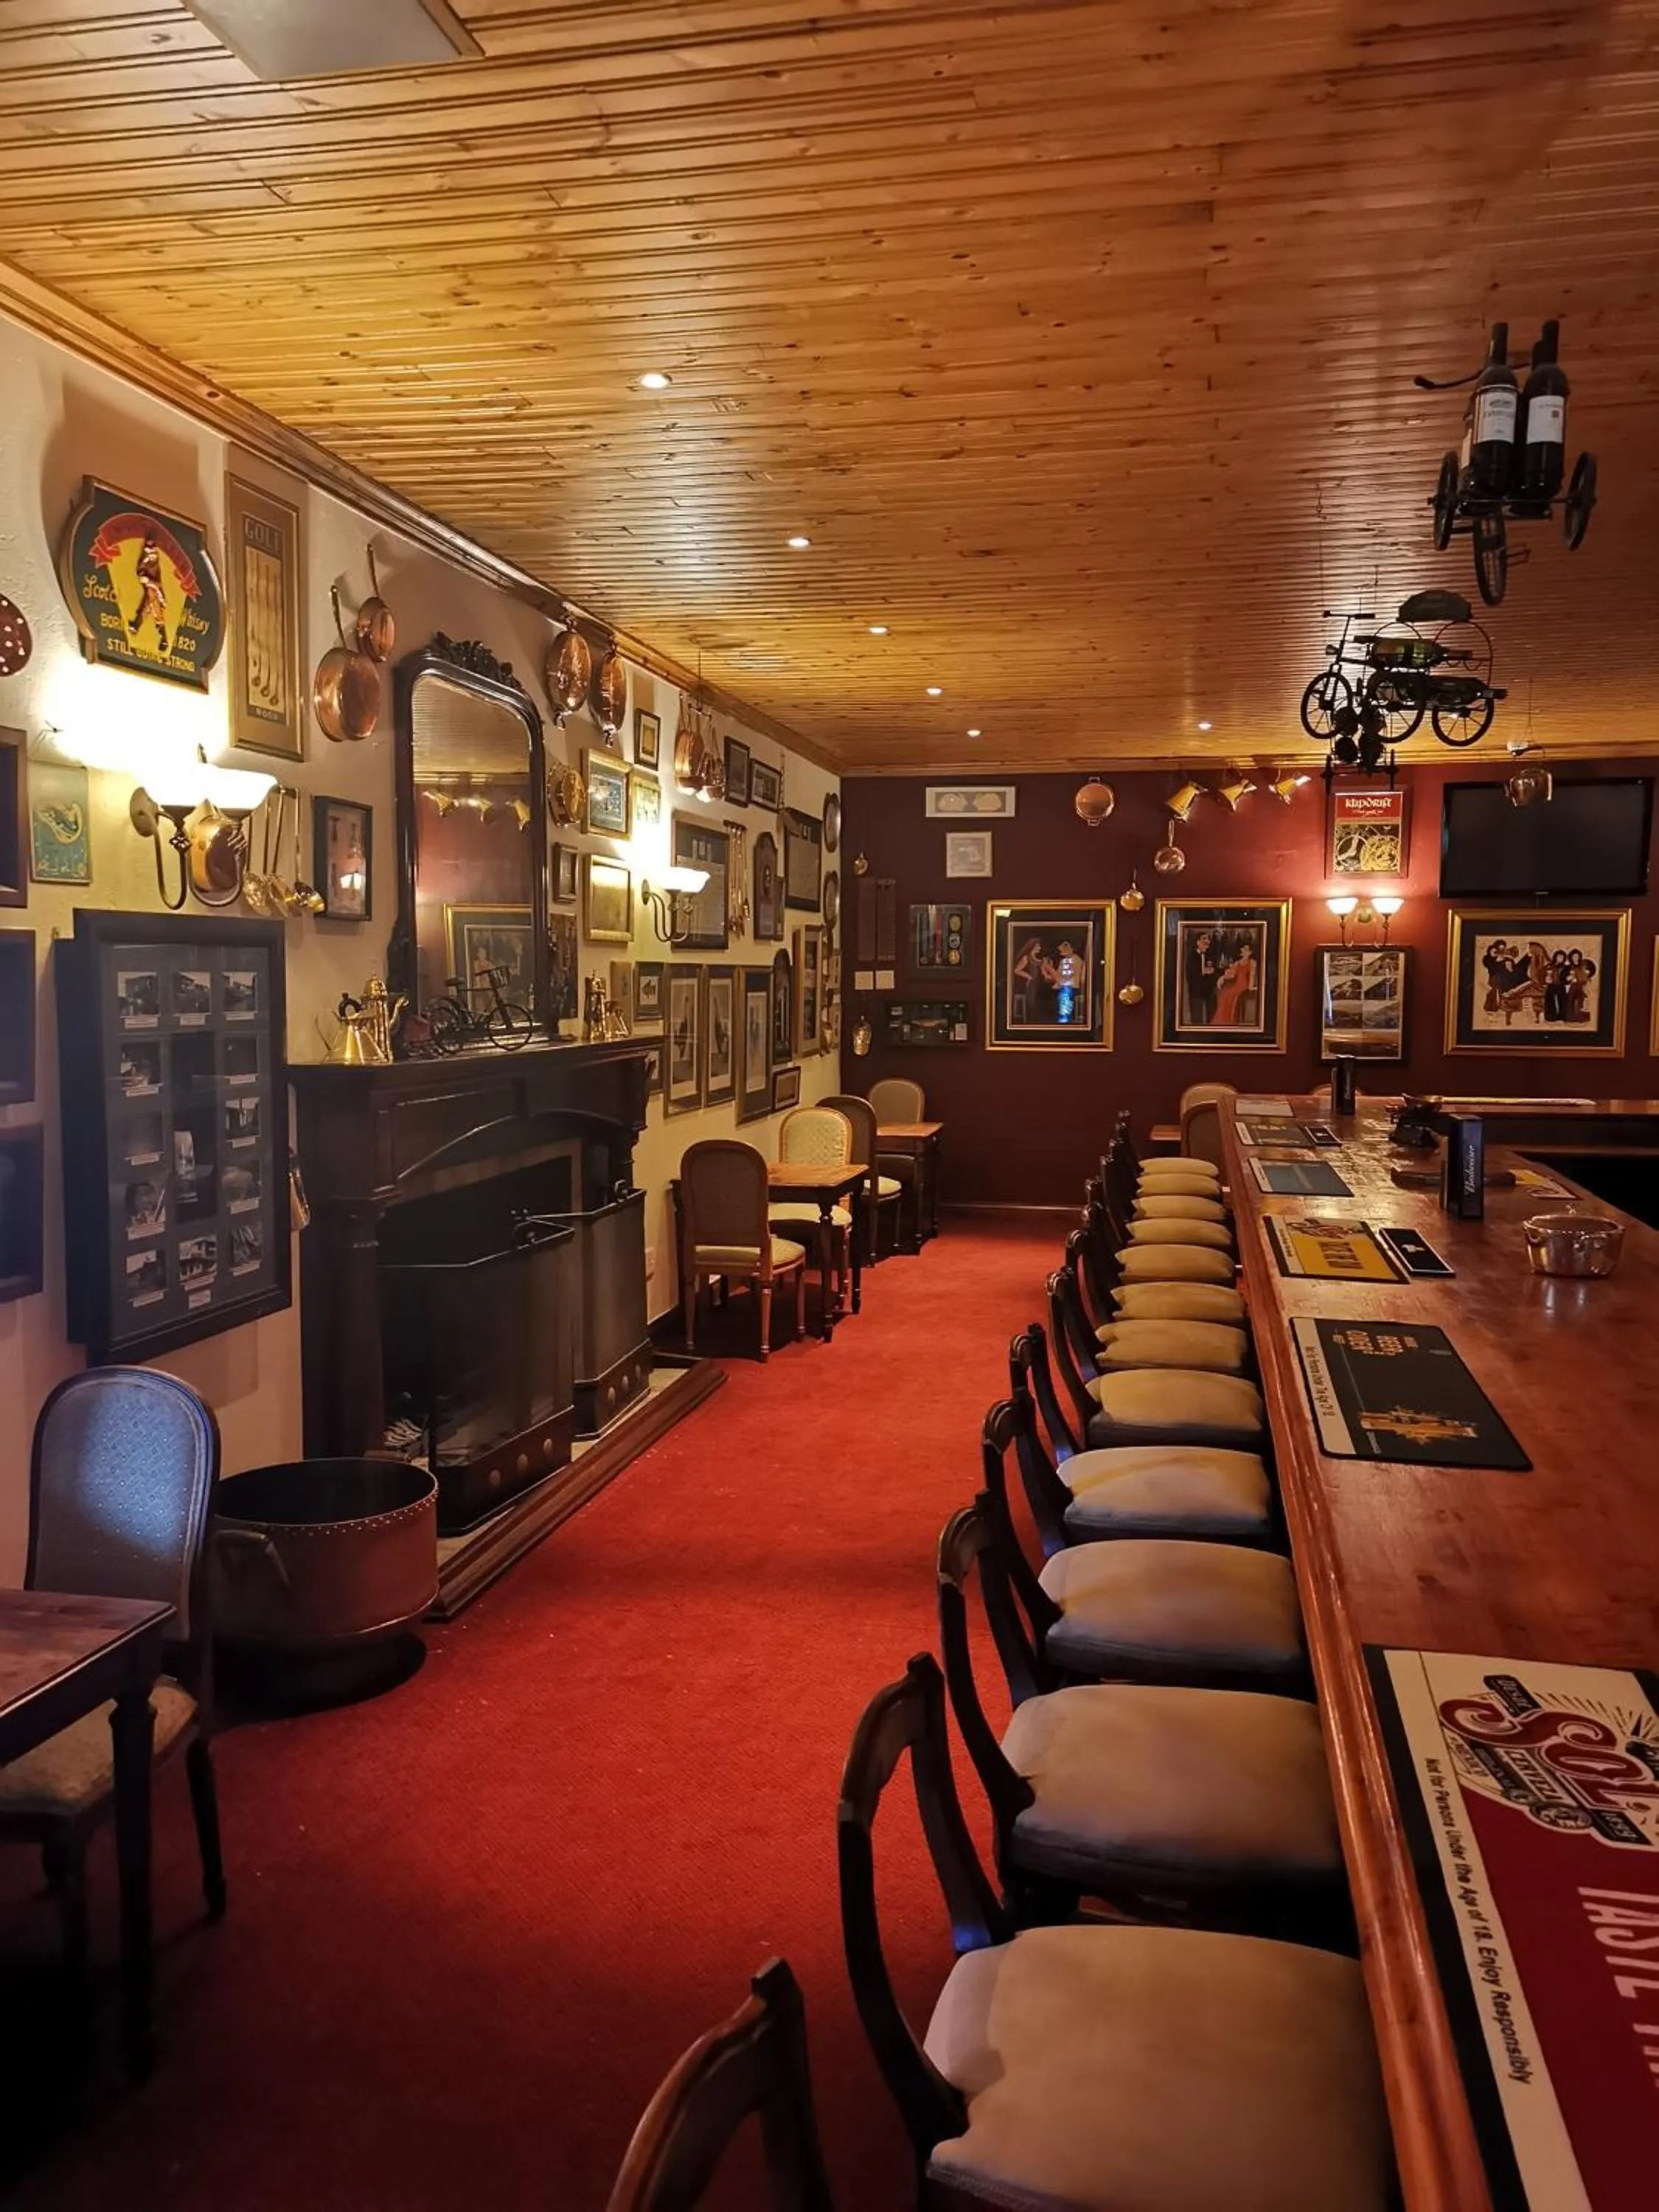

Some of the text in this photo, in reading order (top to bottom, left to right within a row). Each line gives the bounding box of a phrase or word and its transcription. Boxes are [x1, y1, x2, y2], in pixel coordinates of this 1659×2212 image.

[107, 638, 134, 655] STILL
[164, 655, 195, 672] STRONG
[1464, 1144, 1475, 1196] Budweiser
[1425, 1757, 1442, 1773] Not
[1429, 1775, 1447, 1788] for
[1434, 1790, 1455, 1827] Persons
[1445, 1829, 1467, 1860] Under
[1454, 1863, 1473, 1883] the
[1458, 1885, 1478, 1907] Age
[1468, 1908, 1489, 1923] of
[1478, 1945, 1503, 1987] Enjoy
[1490, 1990, 1534, 2085] Responsibly
